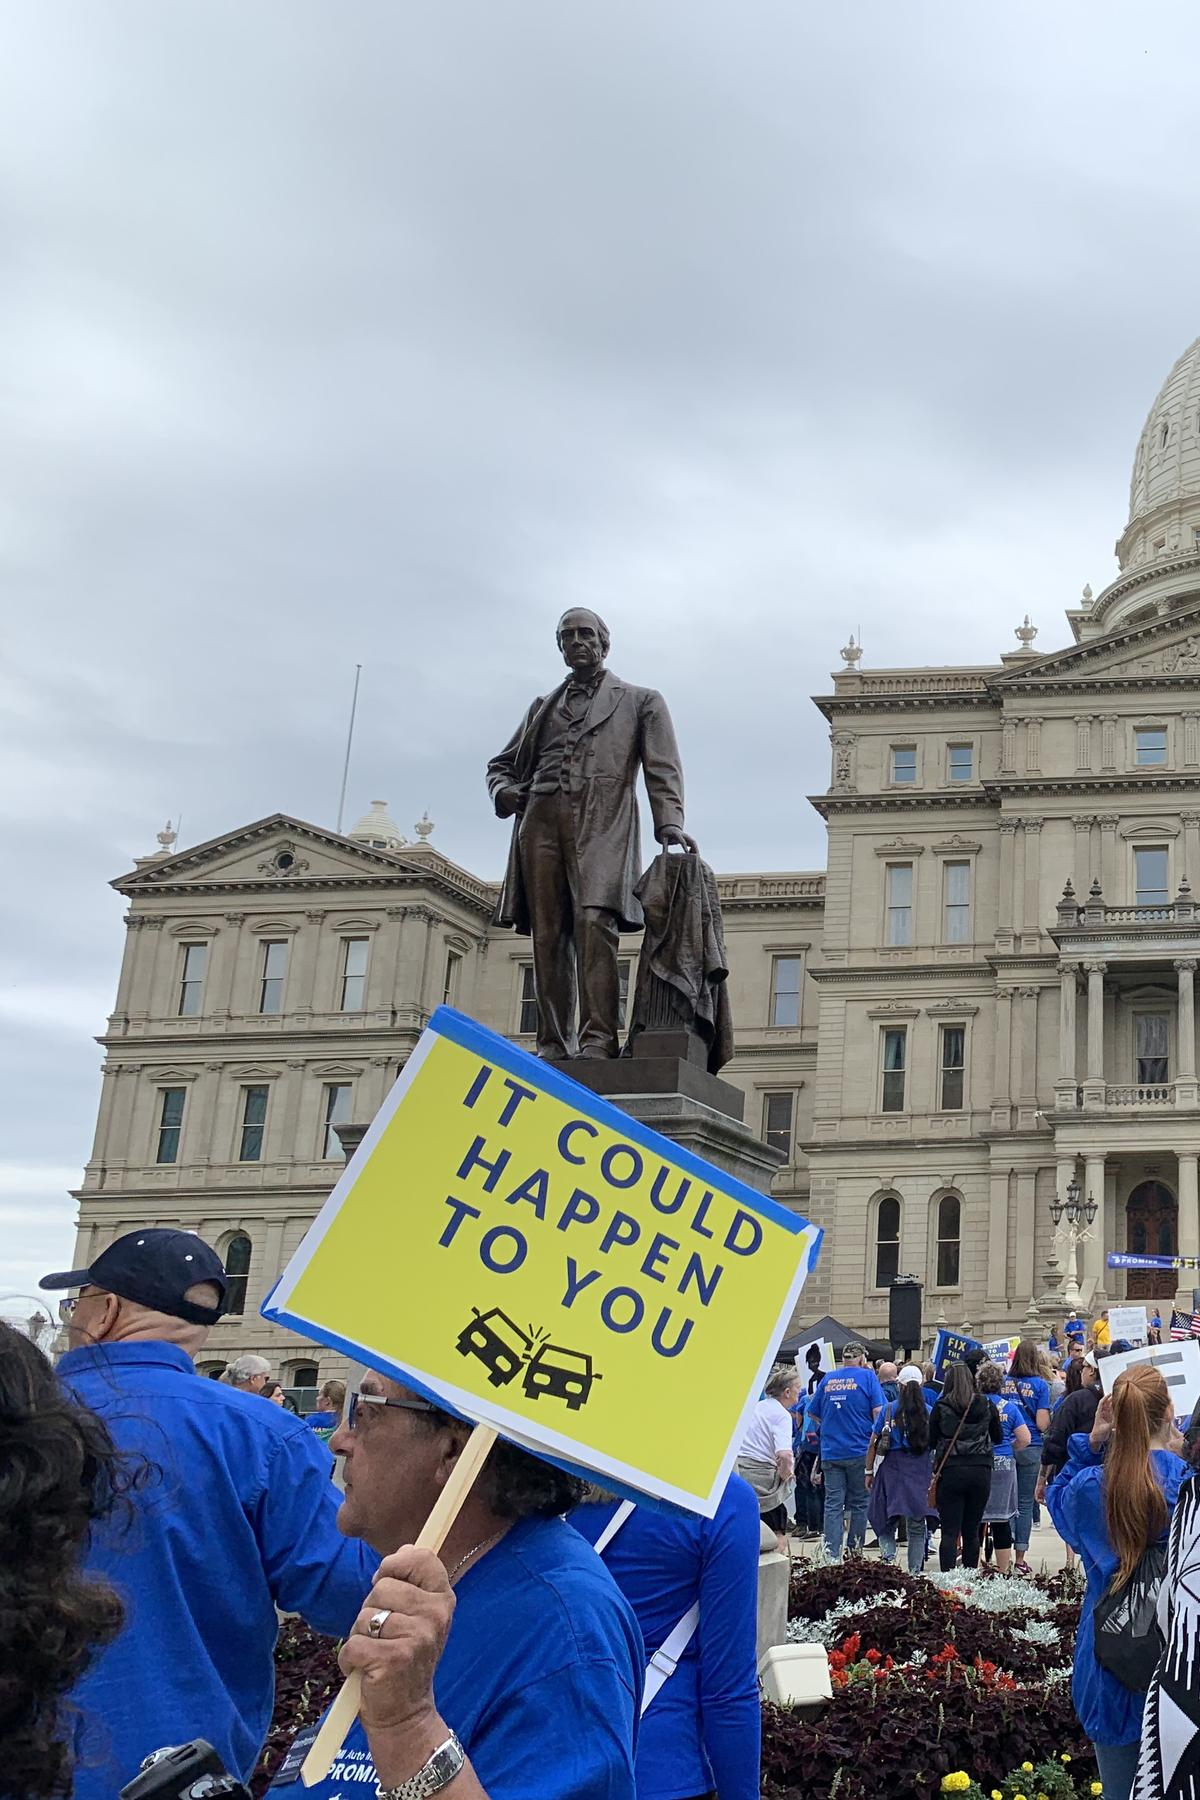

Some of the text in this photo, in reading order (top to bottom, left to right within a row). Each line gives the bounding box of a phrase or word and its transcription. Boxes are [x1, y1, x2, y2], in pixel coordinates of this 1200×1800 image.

[462, 1065, 763, 1257] IT COULD
[456, 1135, 724, 1307] HAPPEN
[438, 1195, 695, 1358] TO YOU
[948, 1337, 967, 1352] FIX
[948, 1350, 961, 1360] THE
[345, 1749, 366, 1761] Auto
